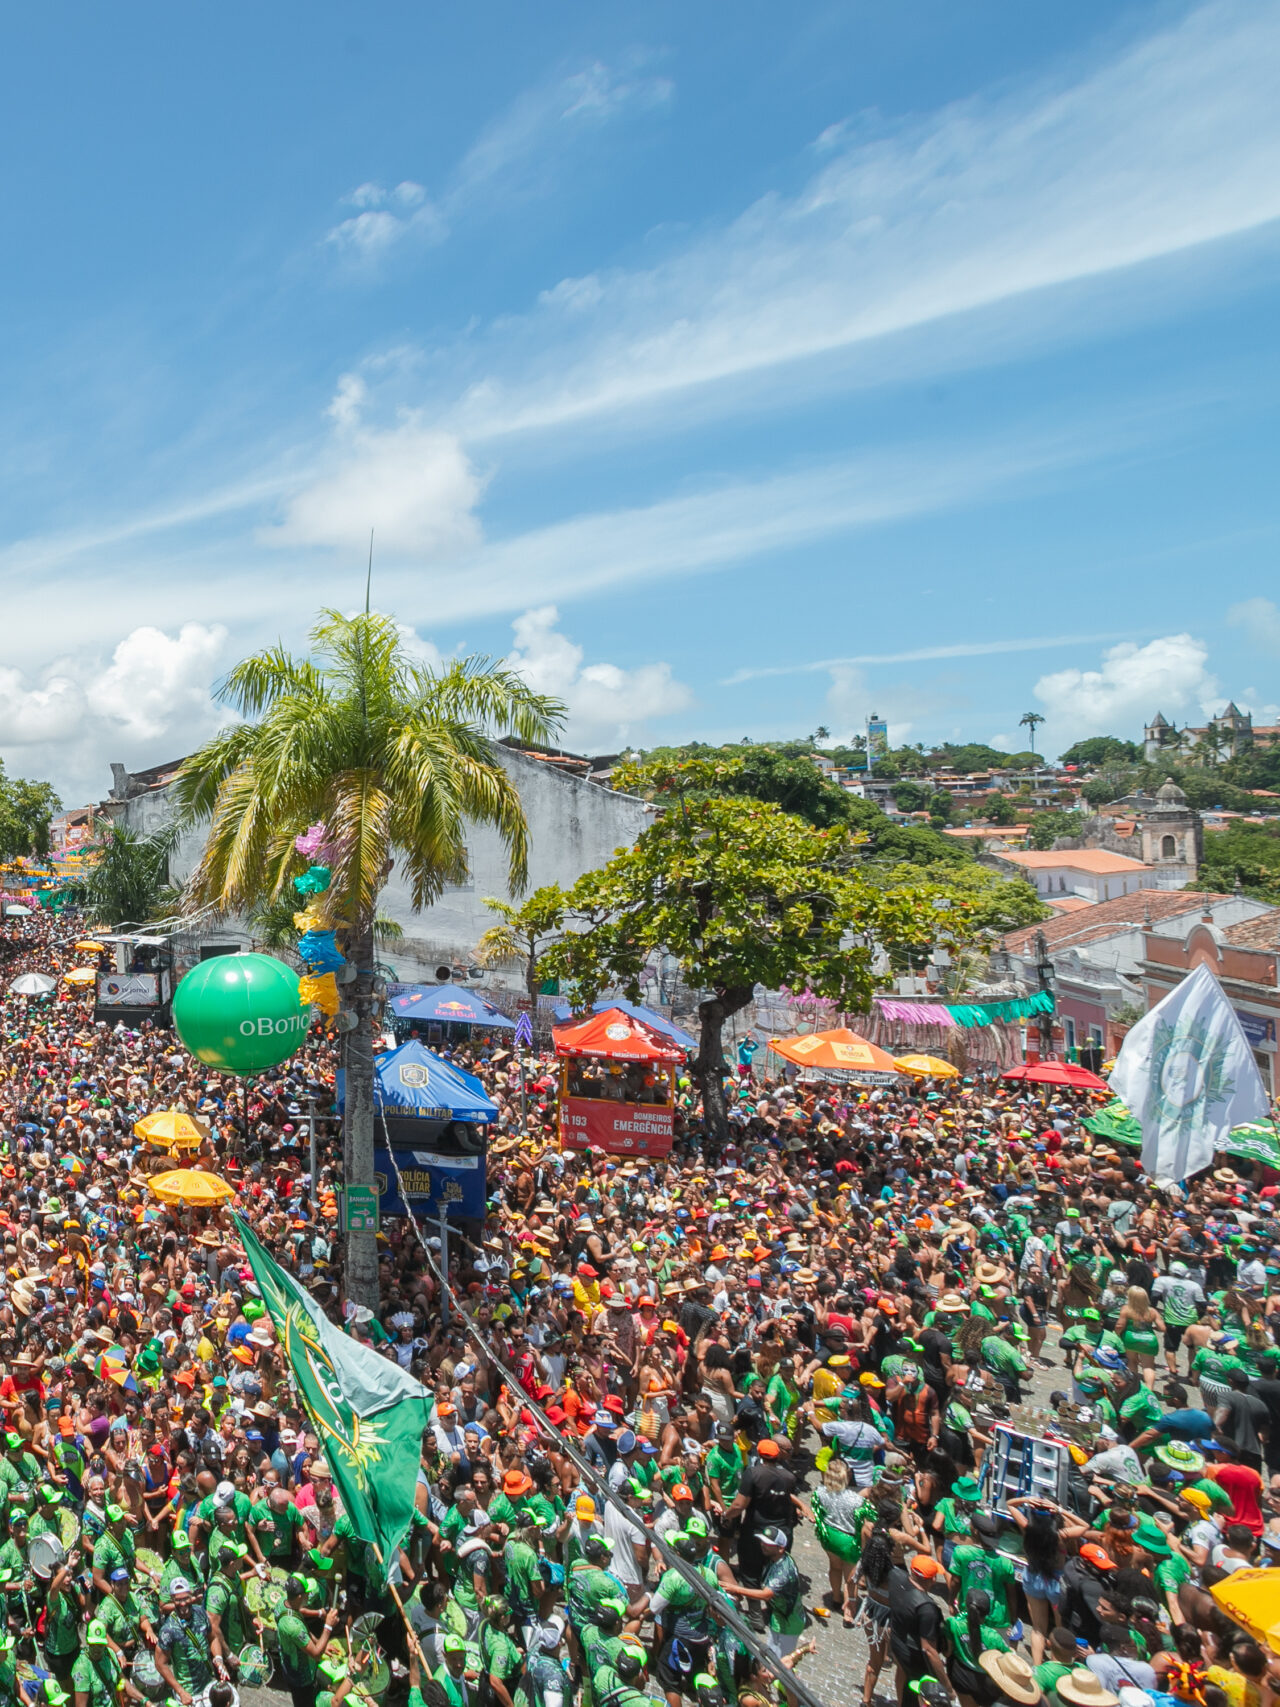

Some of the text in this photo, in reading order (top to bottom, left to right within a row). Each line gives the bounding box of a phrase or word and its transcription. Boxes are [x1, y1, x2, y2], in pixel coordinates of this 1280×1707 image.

[434, 1009, 477, 1019] Red Bull
[419, 1107, 453, 1120] MILITAR
[633, 1112, 672, 1124] BOMBEIROS
[572, 1115, 587, 1127] 193
[613, 1119, 673, 1136] EMERGÊNCIA
